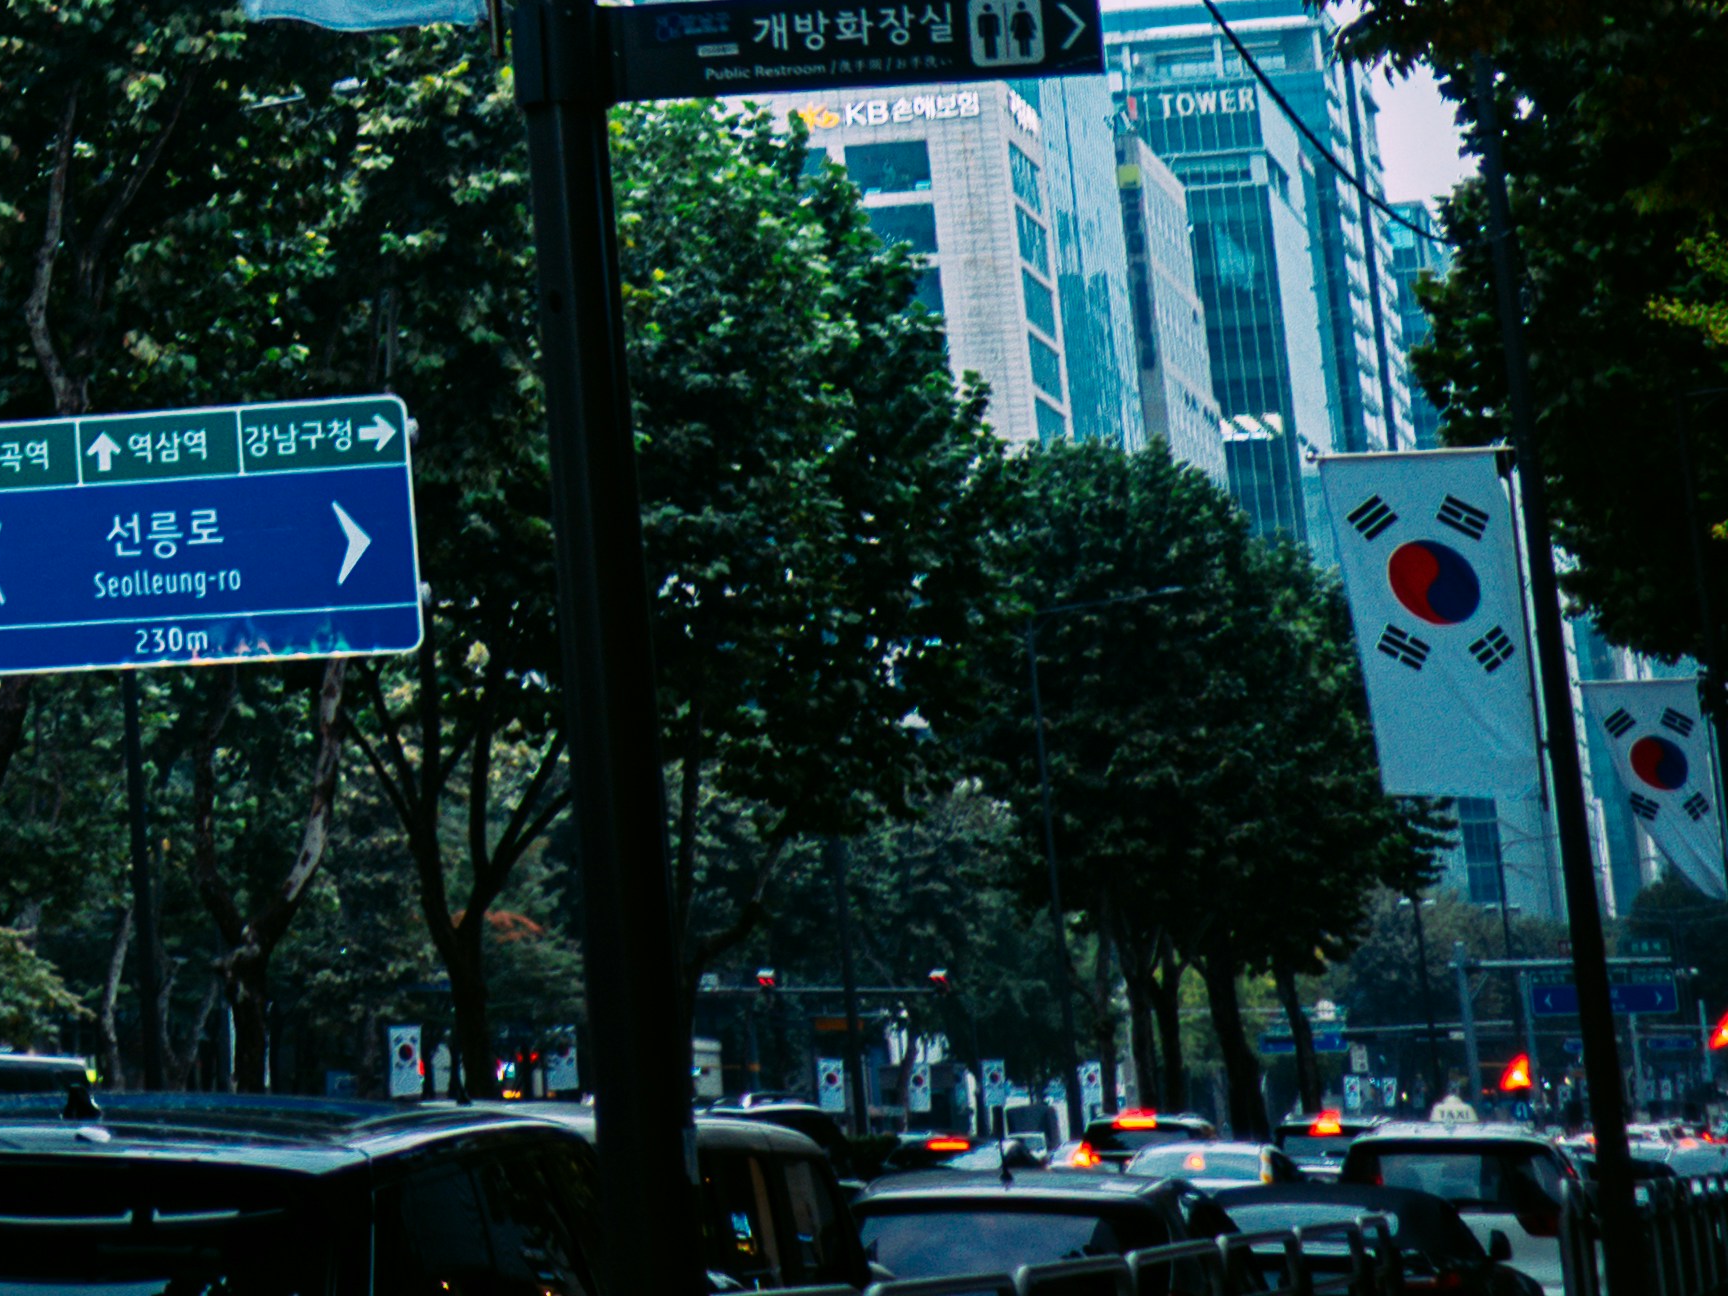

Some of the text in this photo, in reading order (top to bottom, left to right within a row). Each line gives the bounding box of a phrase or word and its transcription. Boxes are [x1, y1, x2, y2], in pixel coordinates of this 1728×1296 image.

[751, 3, 954, 52] 개방화장실
[704, 66, 751, 81] Public
[754, 62, 827, 78] Restroom
[1158, 87, 1256, 119] TOWER
[128, 428, 208, 464] 역삼역
[245, 418, 353, 457] 강남구청
[106, 509, 225, 558] 선릉로
[94, 568, 242, 599] Seolleung-ro
[135, 625, 209, 655] 230m
[1439, 1108, 1470, 1121] TAXI
